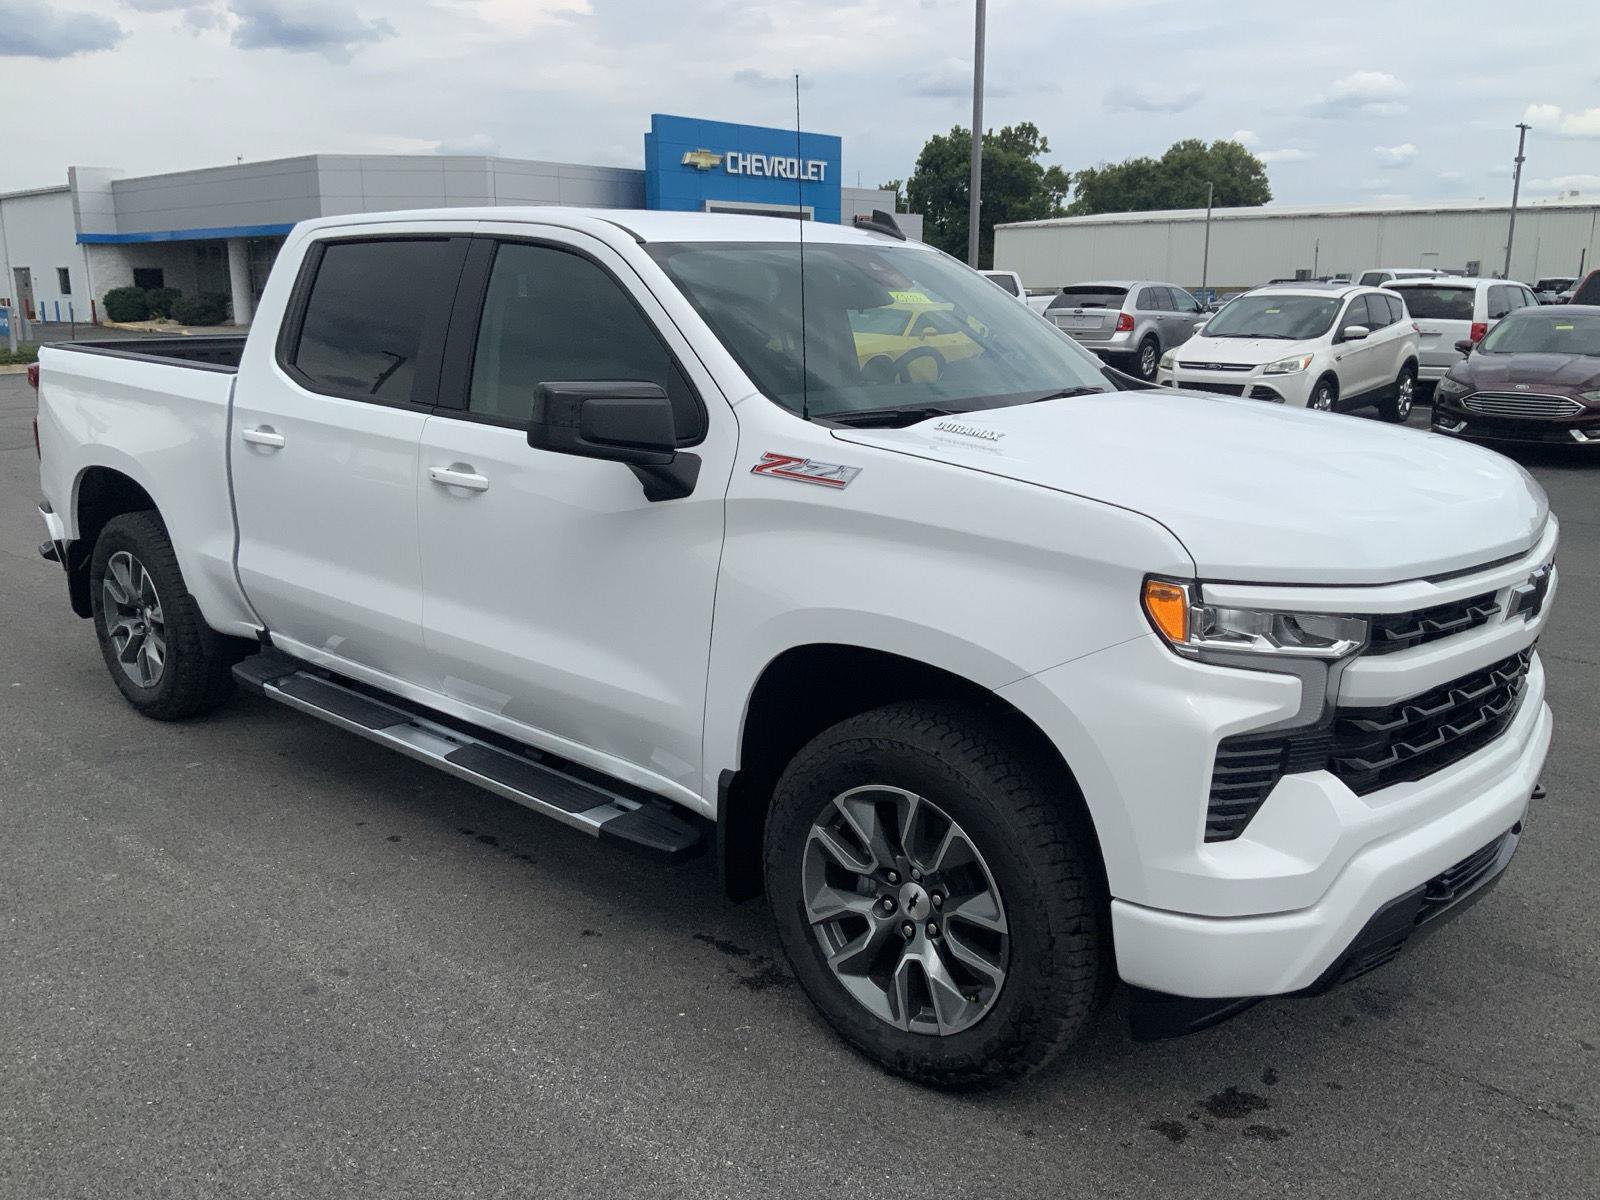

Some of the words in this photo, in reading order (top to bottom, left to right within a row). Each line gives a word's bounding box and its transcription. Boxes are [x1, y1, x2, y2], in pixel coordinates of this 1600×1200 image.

[726, 151, 828, 181] CHEVROLET
[934, 422, 1005, 441] DURAMAX
[750, 451, 863, 490] Z71
